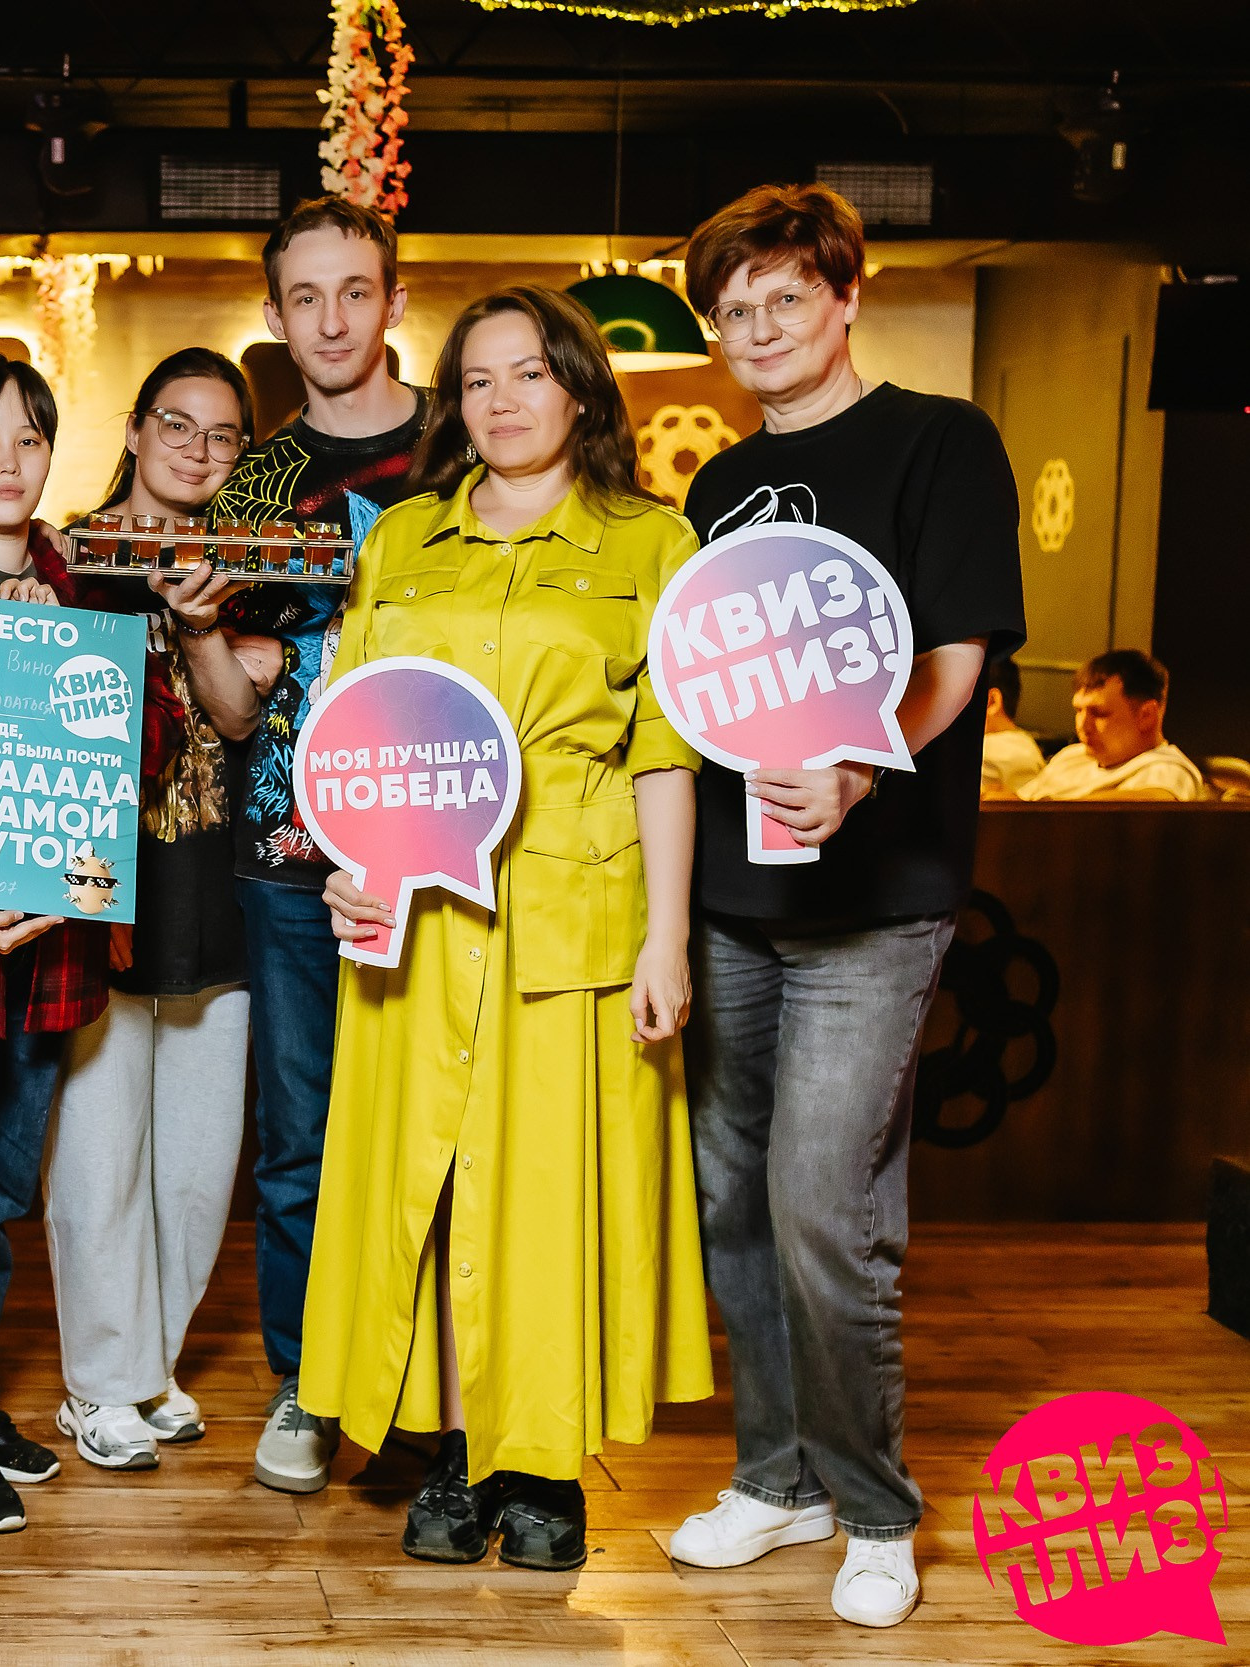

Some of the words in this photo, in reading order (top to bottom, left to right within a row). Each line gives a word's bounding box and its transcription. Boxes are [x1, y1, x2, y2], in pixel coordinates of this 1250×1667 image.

[665, 559, 885, 669] КВИЗ,
[51, 667, 130, 699] КВИЗ,
[676, 614, 900, 734] ПЛИЗ!
[53, 692, 132, 725] ПЛИЗ!
[16, 743, 64, 762] БЫЛА
[66, 749, 122, 768] ПОЧТИ
[309, 747, 371, 773] МОЯ
[377, 738, 499, 769] ЛУЧШАЯ
[315, 768, 500, 812] ПОБЕДА
